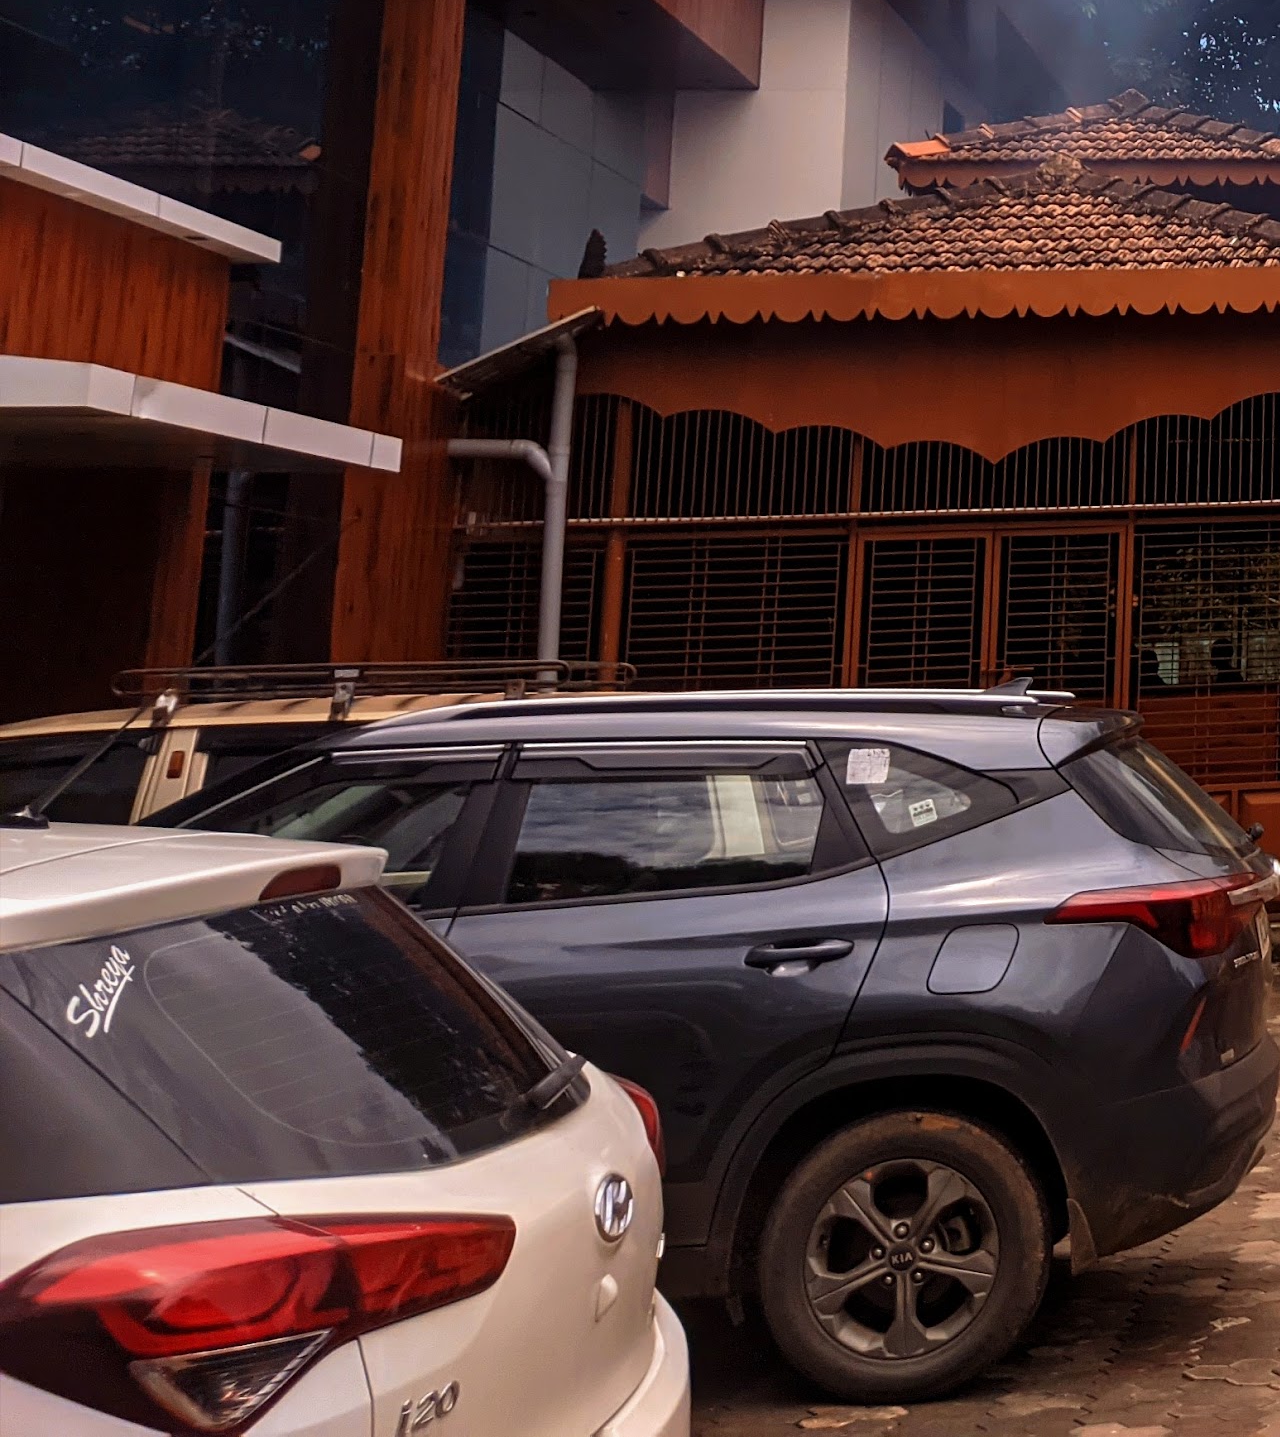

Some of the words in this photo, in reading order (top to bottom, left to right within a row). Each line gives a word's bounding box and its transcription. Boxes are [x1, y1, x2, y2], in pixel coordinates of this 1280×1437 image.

[66, 945, 135, 1039] Shreya
[891, 1252, 913, 1265] KIA
[394, 1380, 460, 1437] i20
